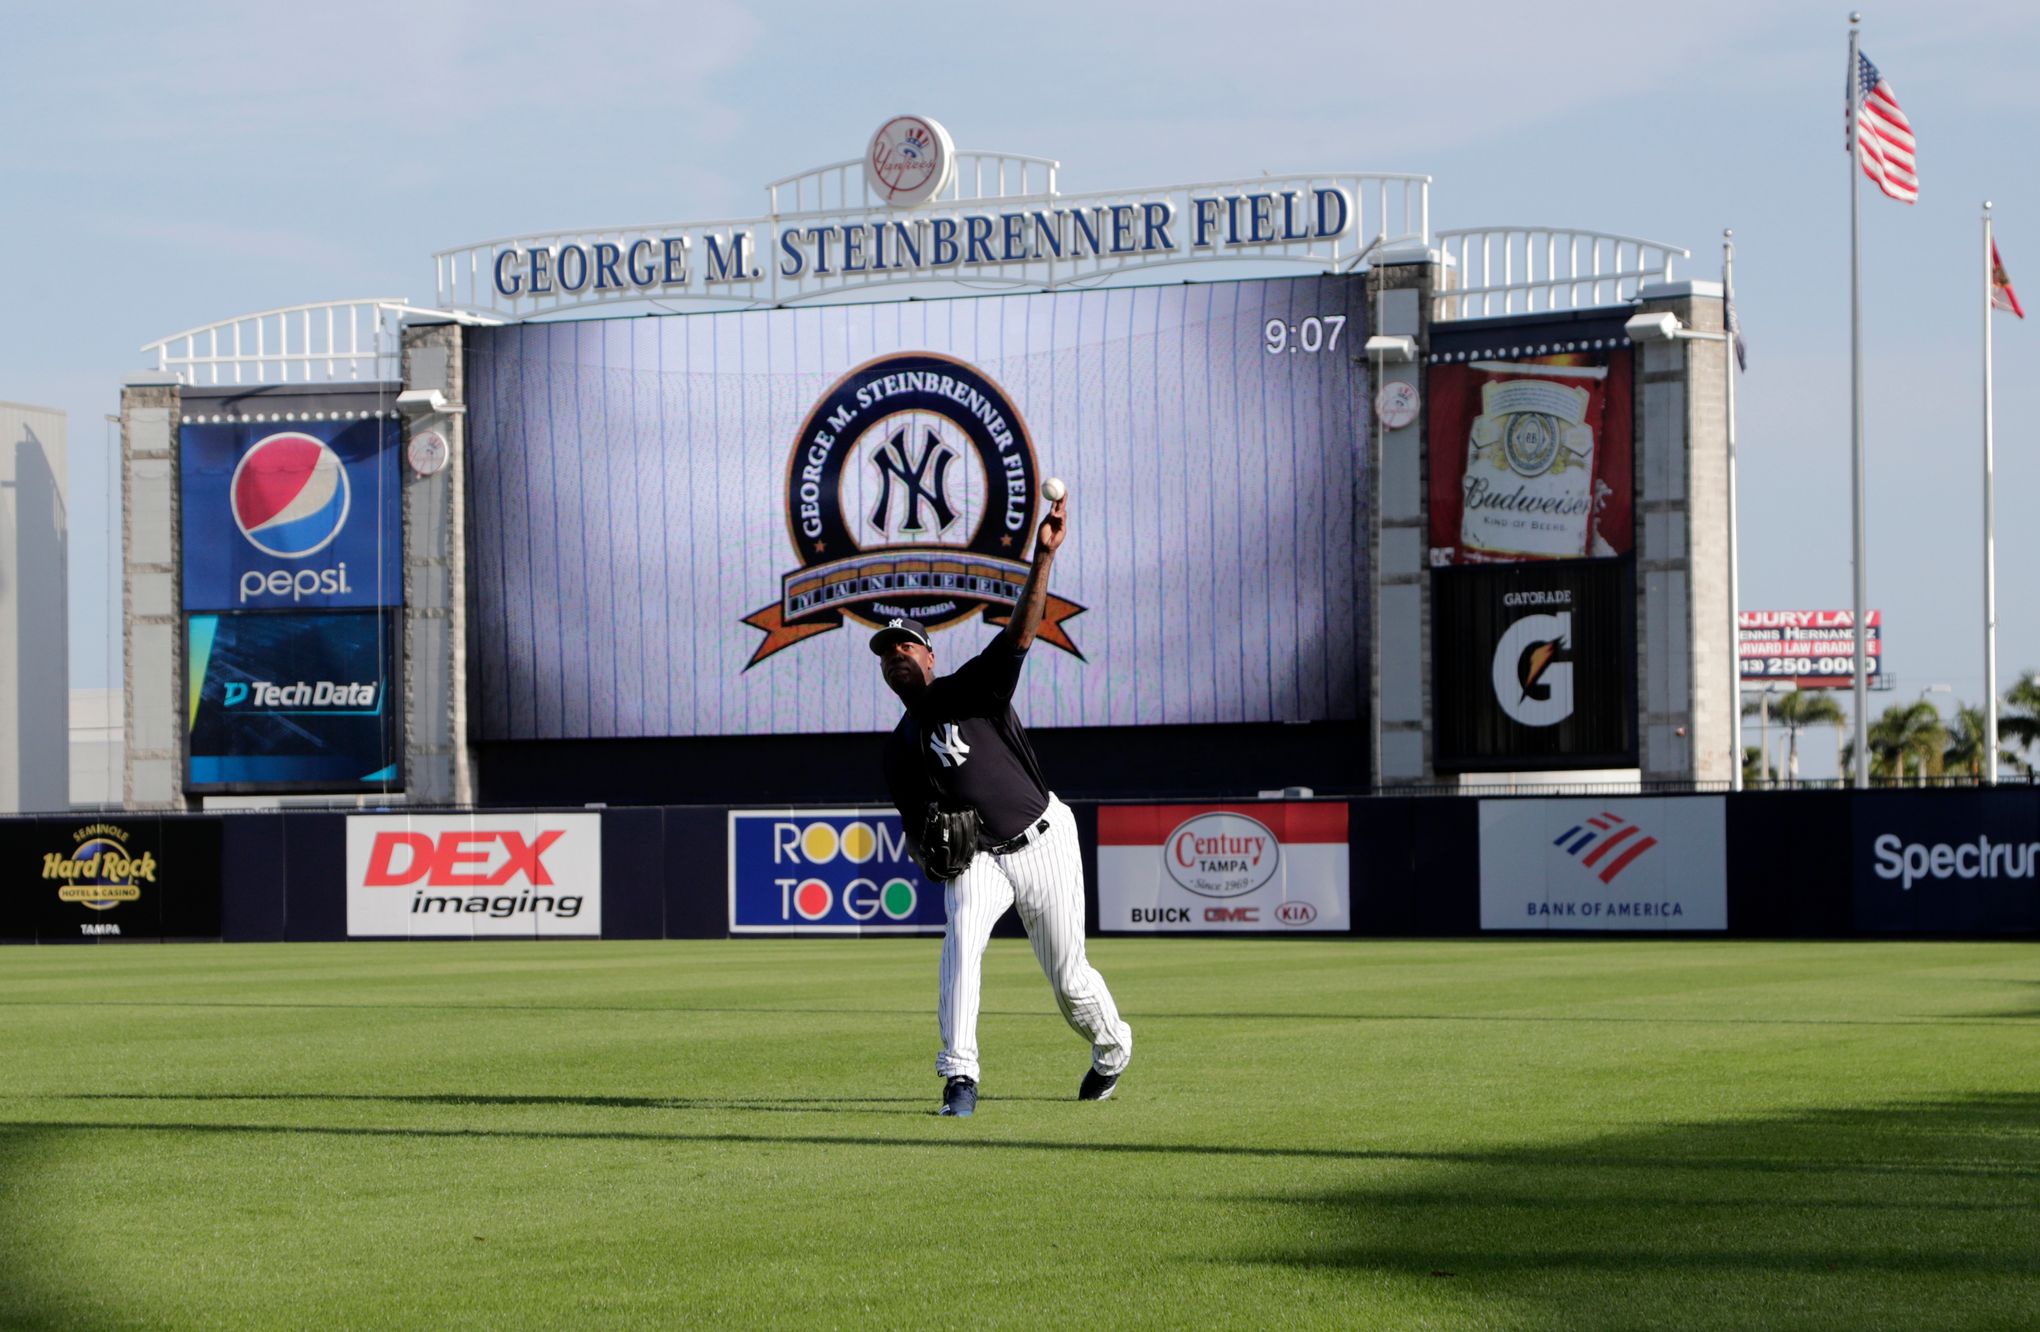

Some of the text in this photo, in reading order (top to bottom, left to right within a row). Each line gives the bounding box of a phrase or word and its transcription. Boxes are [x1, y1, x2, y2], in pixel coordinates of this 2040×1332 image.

[494, 187, 1348, 296] GEORGE M. STEINBRENNER FIELD
[1265, 315, 1347, 354] 9:07
[800, 371, 1027, 538] GEORGE M. STEINBRENNER FIELD
[1465, 475, 1590, 515] Budweiser
[239, 562, 346, 604] pepsi
[1504, 590, 1572, 606] GATORADE
[910, 600, 957, 618] FLORIDA
[1738, 611, 1813, 626] NJURY
[1740, 627, 1876, 640] ENNIS HERNANZ
[1740, 640, 1876, 655] RVARD LAW GRADUE
[1741, 659, 1764, 673] 13)
[72, 823, 130, 843] SEMINOLE
[774, 821, 914, 865] ROOM
[1175, 831, 1266, 868] Century
[42, 851, 157, 883] Hard Rock
[363, 830, 567, 888] DEX
[1200, 860, 1249, 873] TAMPA
[62, 886, 91, 897] HOTEL
[102, 886, 137, 897] CASINO
[1193, 877, 1250, 892] Since 1969
[411, 889, 584, 918] imaging
[774, 877, 918, 921] TO GO
[1131, 906, 1311, 923] BUICK GMC KIA
[1527, 902, 1683, 917] BANK OF AMERICA
[80, 924, 121, 936] TAMPA
